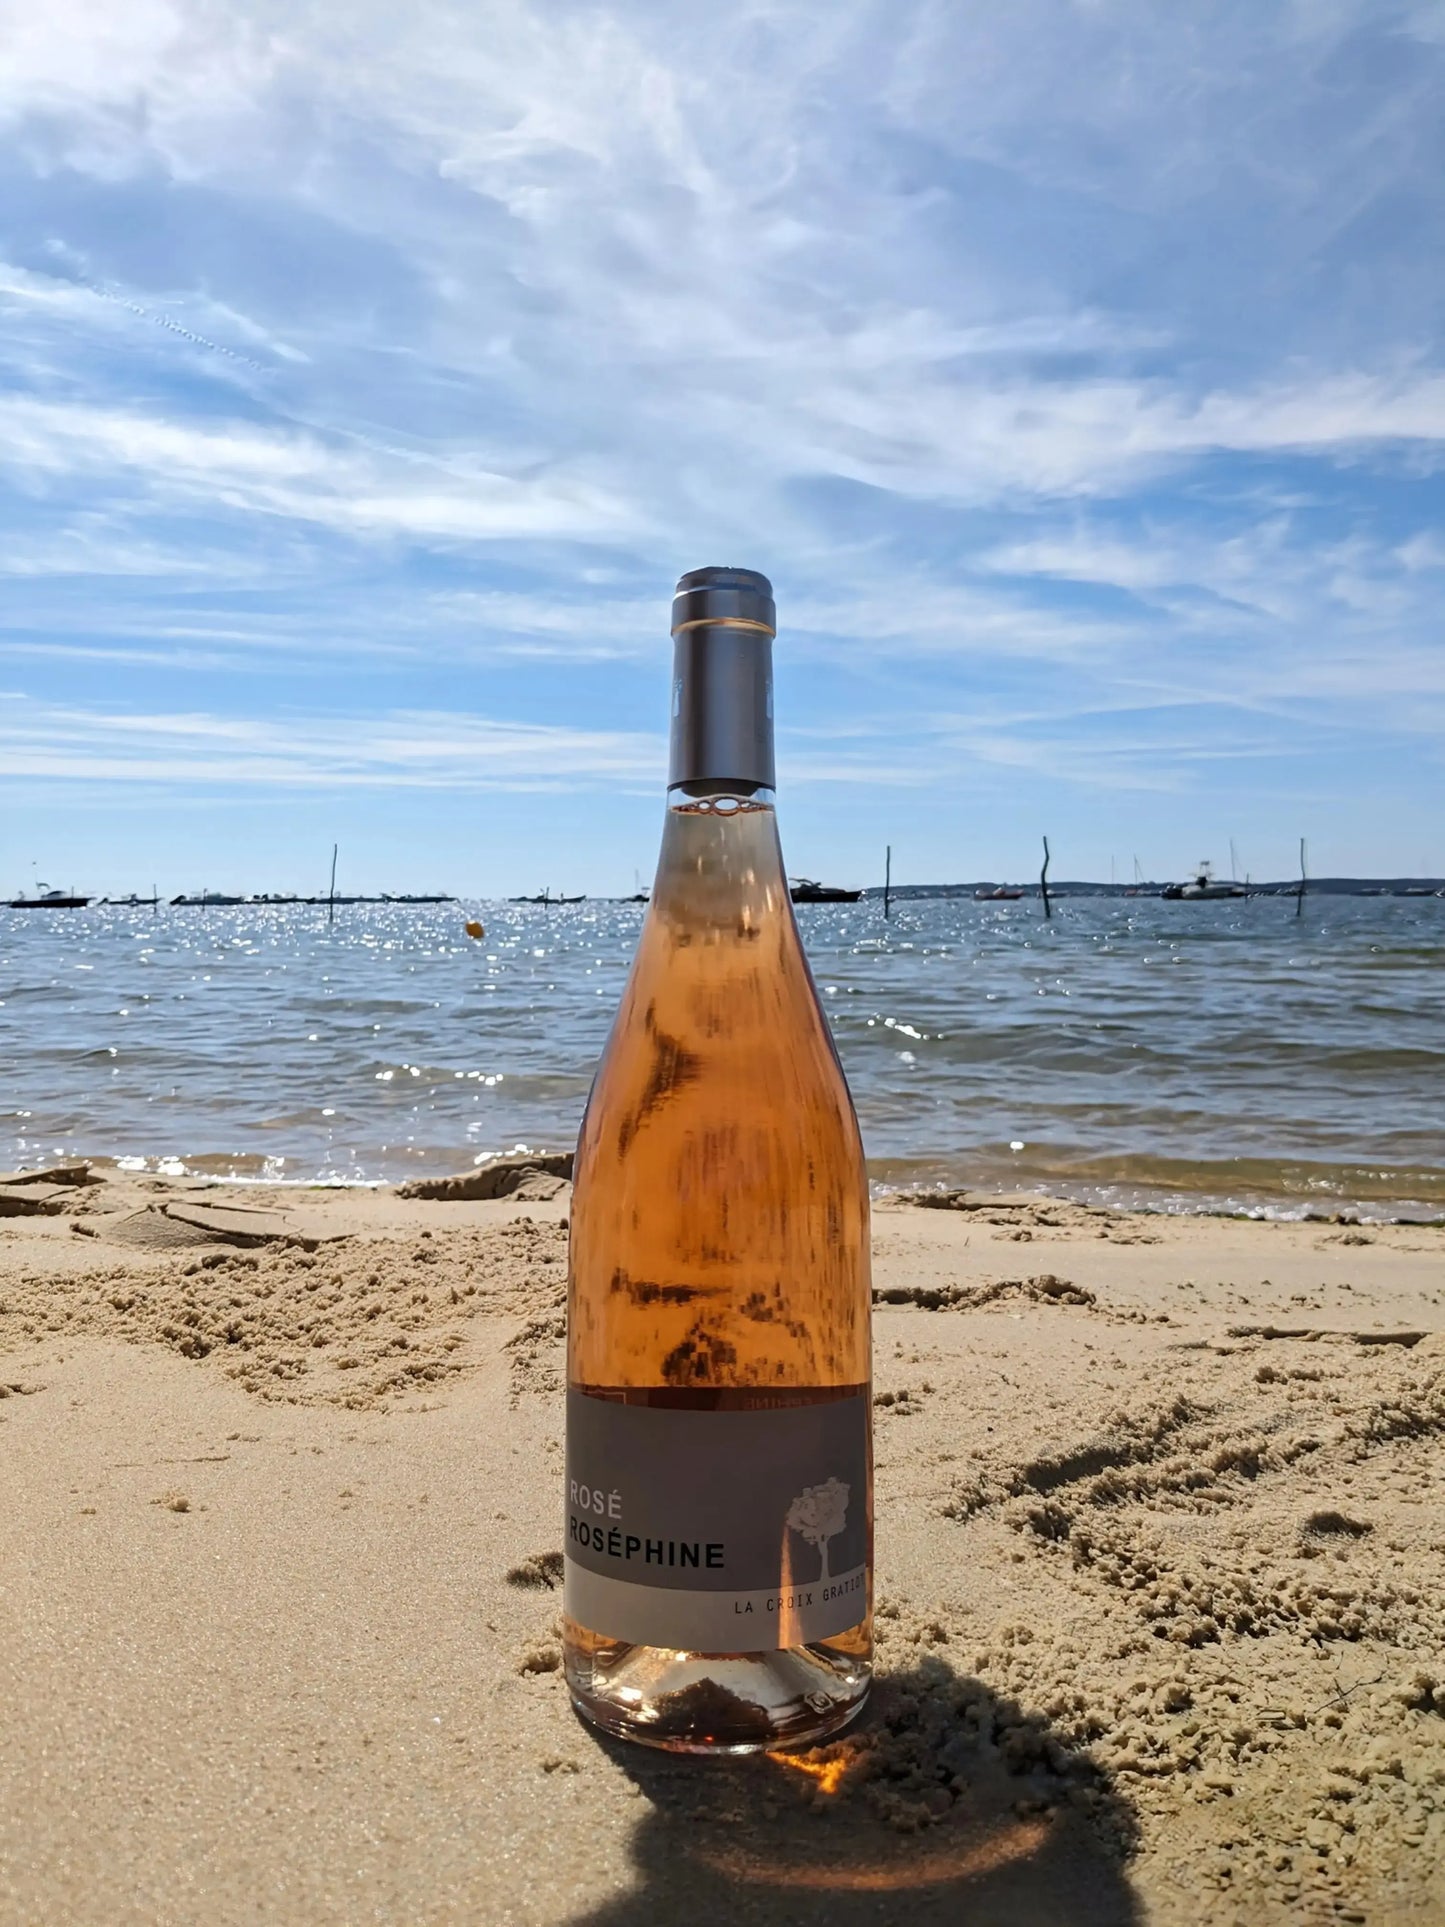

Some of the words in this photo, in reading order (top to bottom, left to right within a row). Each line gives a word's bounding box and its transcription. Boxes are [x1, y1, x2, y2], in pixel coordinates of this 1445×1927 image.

[570, 1479, 622, 1519] ROSÉ
[570, 1515, 725, 1569] ROSÉPHINE
[734, 1600, 754, 1614] LA
[766, 1592, 813, 1612] CROIX
